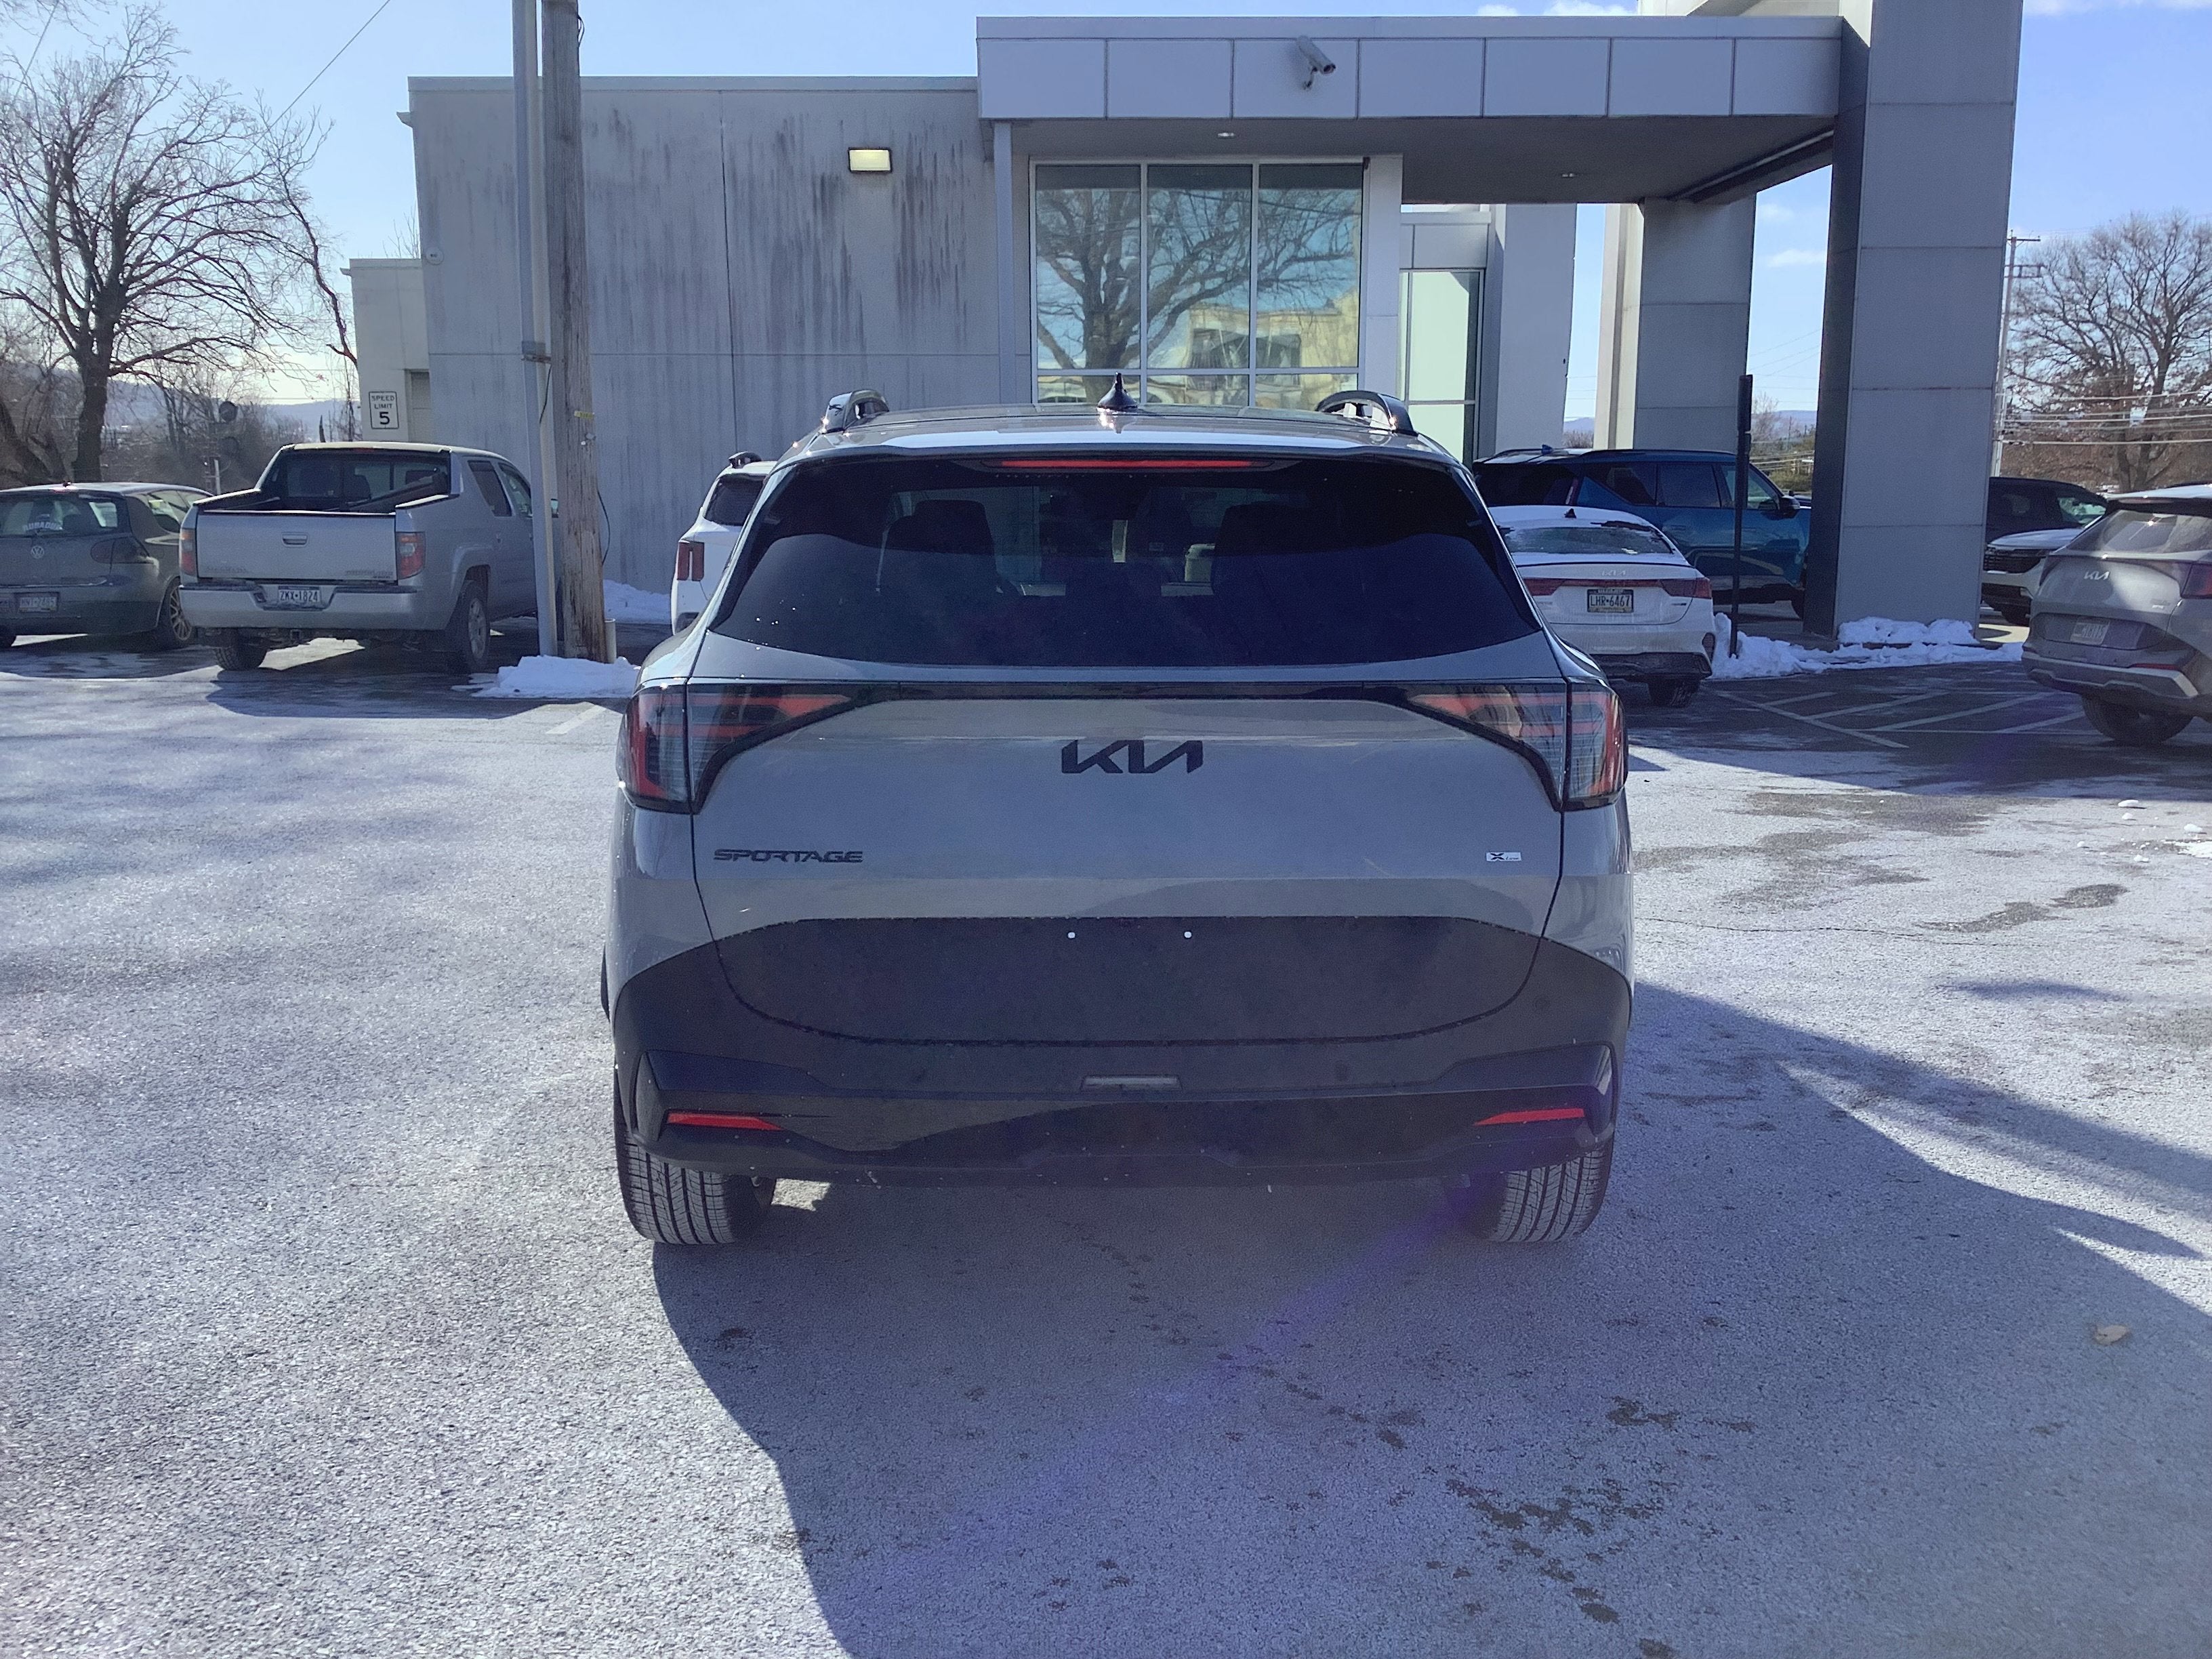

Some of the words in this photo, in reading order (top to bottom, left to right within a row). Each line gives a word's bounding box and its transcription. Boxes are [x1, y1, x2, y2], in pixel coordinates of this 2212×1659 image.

[380, 411, 390, 425] 5
[2084, 571, 2110, 580] KIA
[1061, 739, 1204, 774] KIA
[714, 848, 863, 863] SPORTAGE
